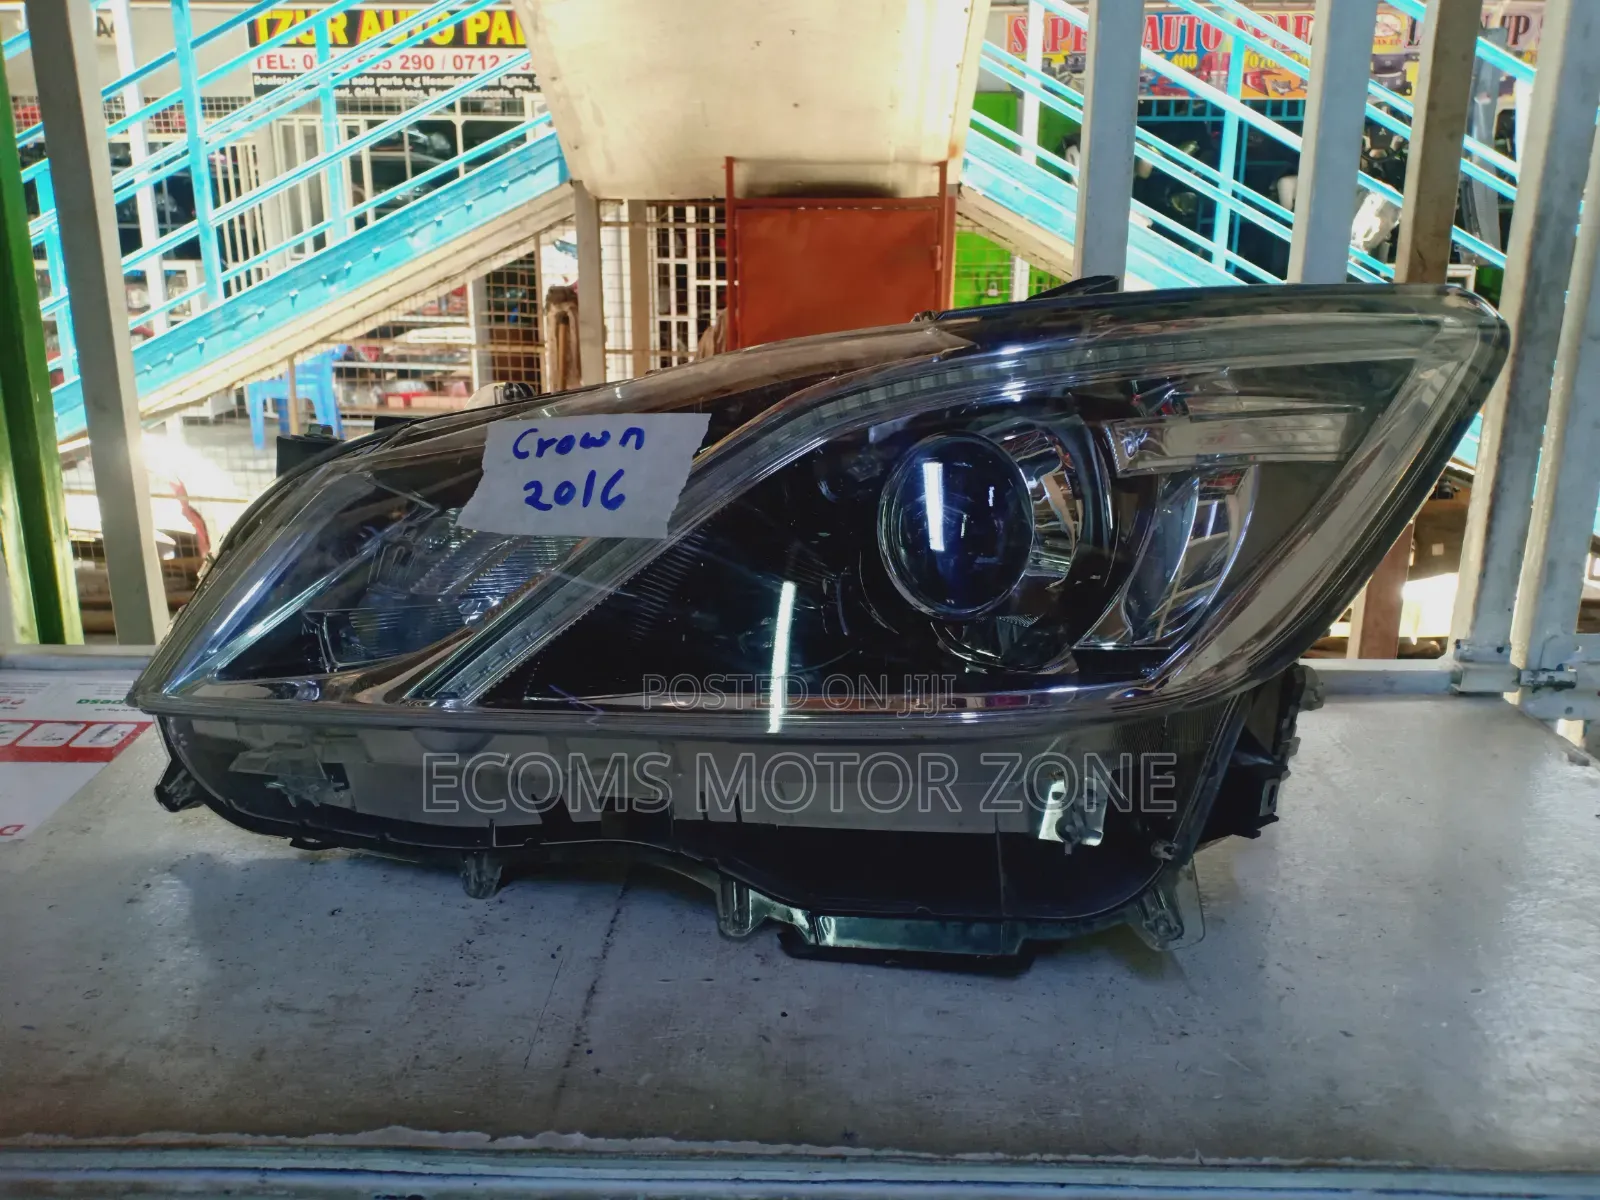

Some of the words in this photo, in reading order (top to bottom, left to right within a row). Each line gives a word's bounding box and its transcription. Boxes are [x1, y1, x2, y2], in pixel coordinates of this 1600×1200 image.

[1142, 14, 1223, 52] AUTO
[399, 54, 434, 70] 290
[452, 54, 500, 70] 0712
[512, 426, 645, 460] Crown
[523, 468, 627, 511] 2016
